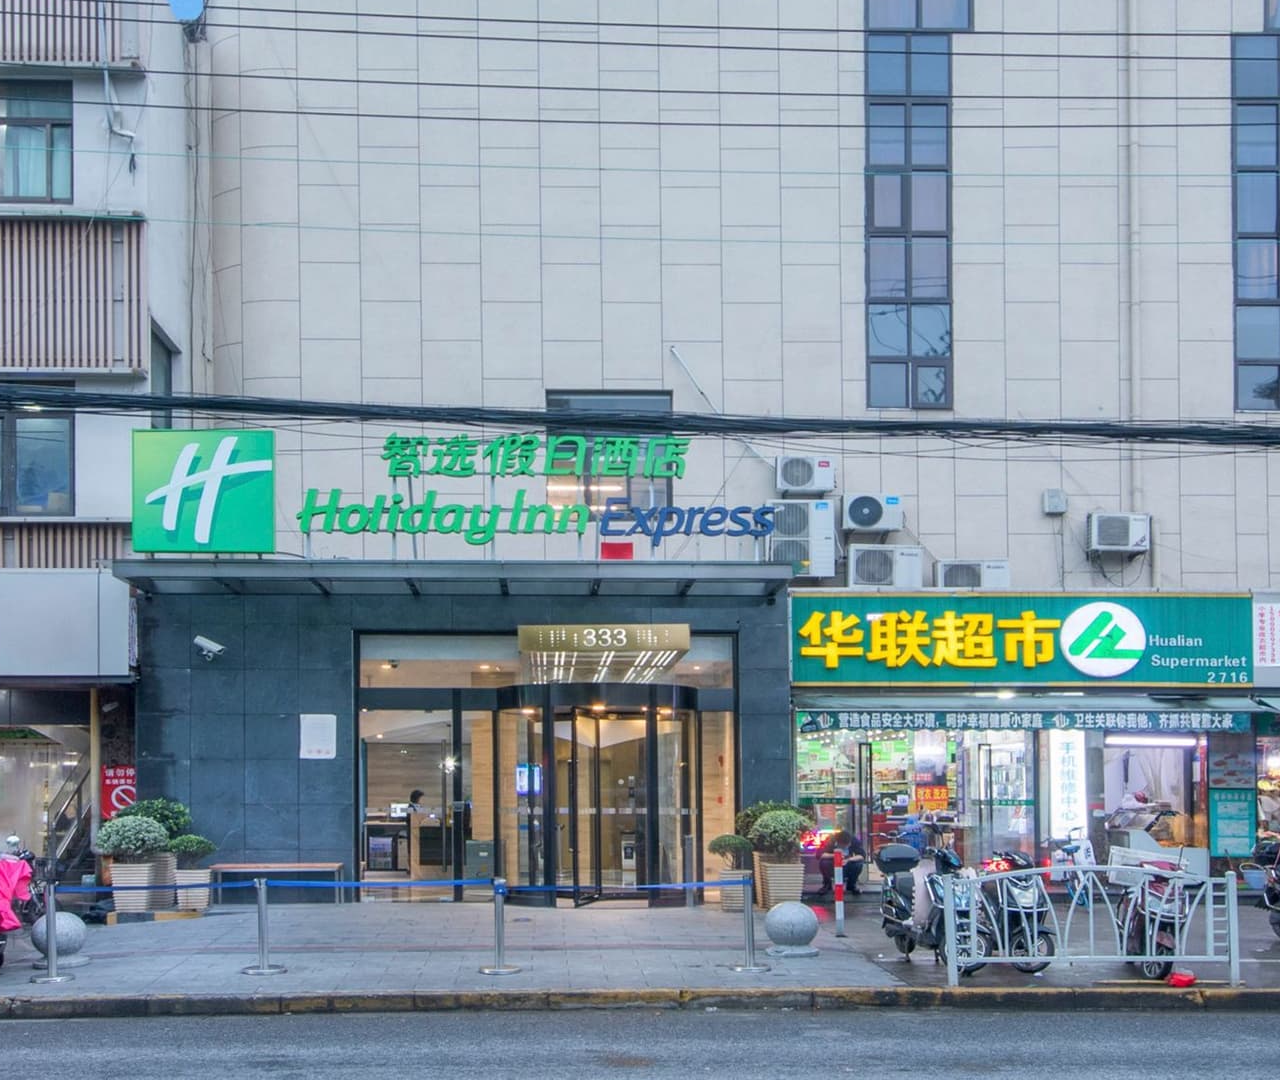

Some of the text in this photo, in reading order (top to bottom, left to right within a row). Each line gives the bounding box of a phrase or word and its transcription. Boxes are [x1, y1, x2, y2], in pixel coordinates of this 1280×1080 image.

[380, 431, 692, 479] 智选假日酒店
[297, 488, 777, 547] Holiday Inn Express
[583, 628, 628, 647] 333
[799, 610, 1061, 668] 华联超市
[1149, 634, 1203, 648] Hualian
[1151, 655, 1247, 669] Supermarket
[1207, 672, 1248, 683] 2716
